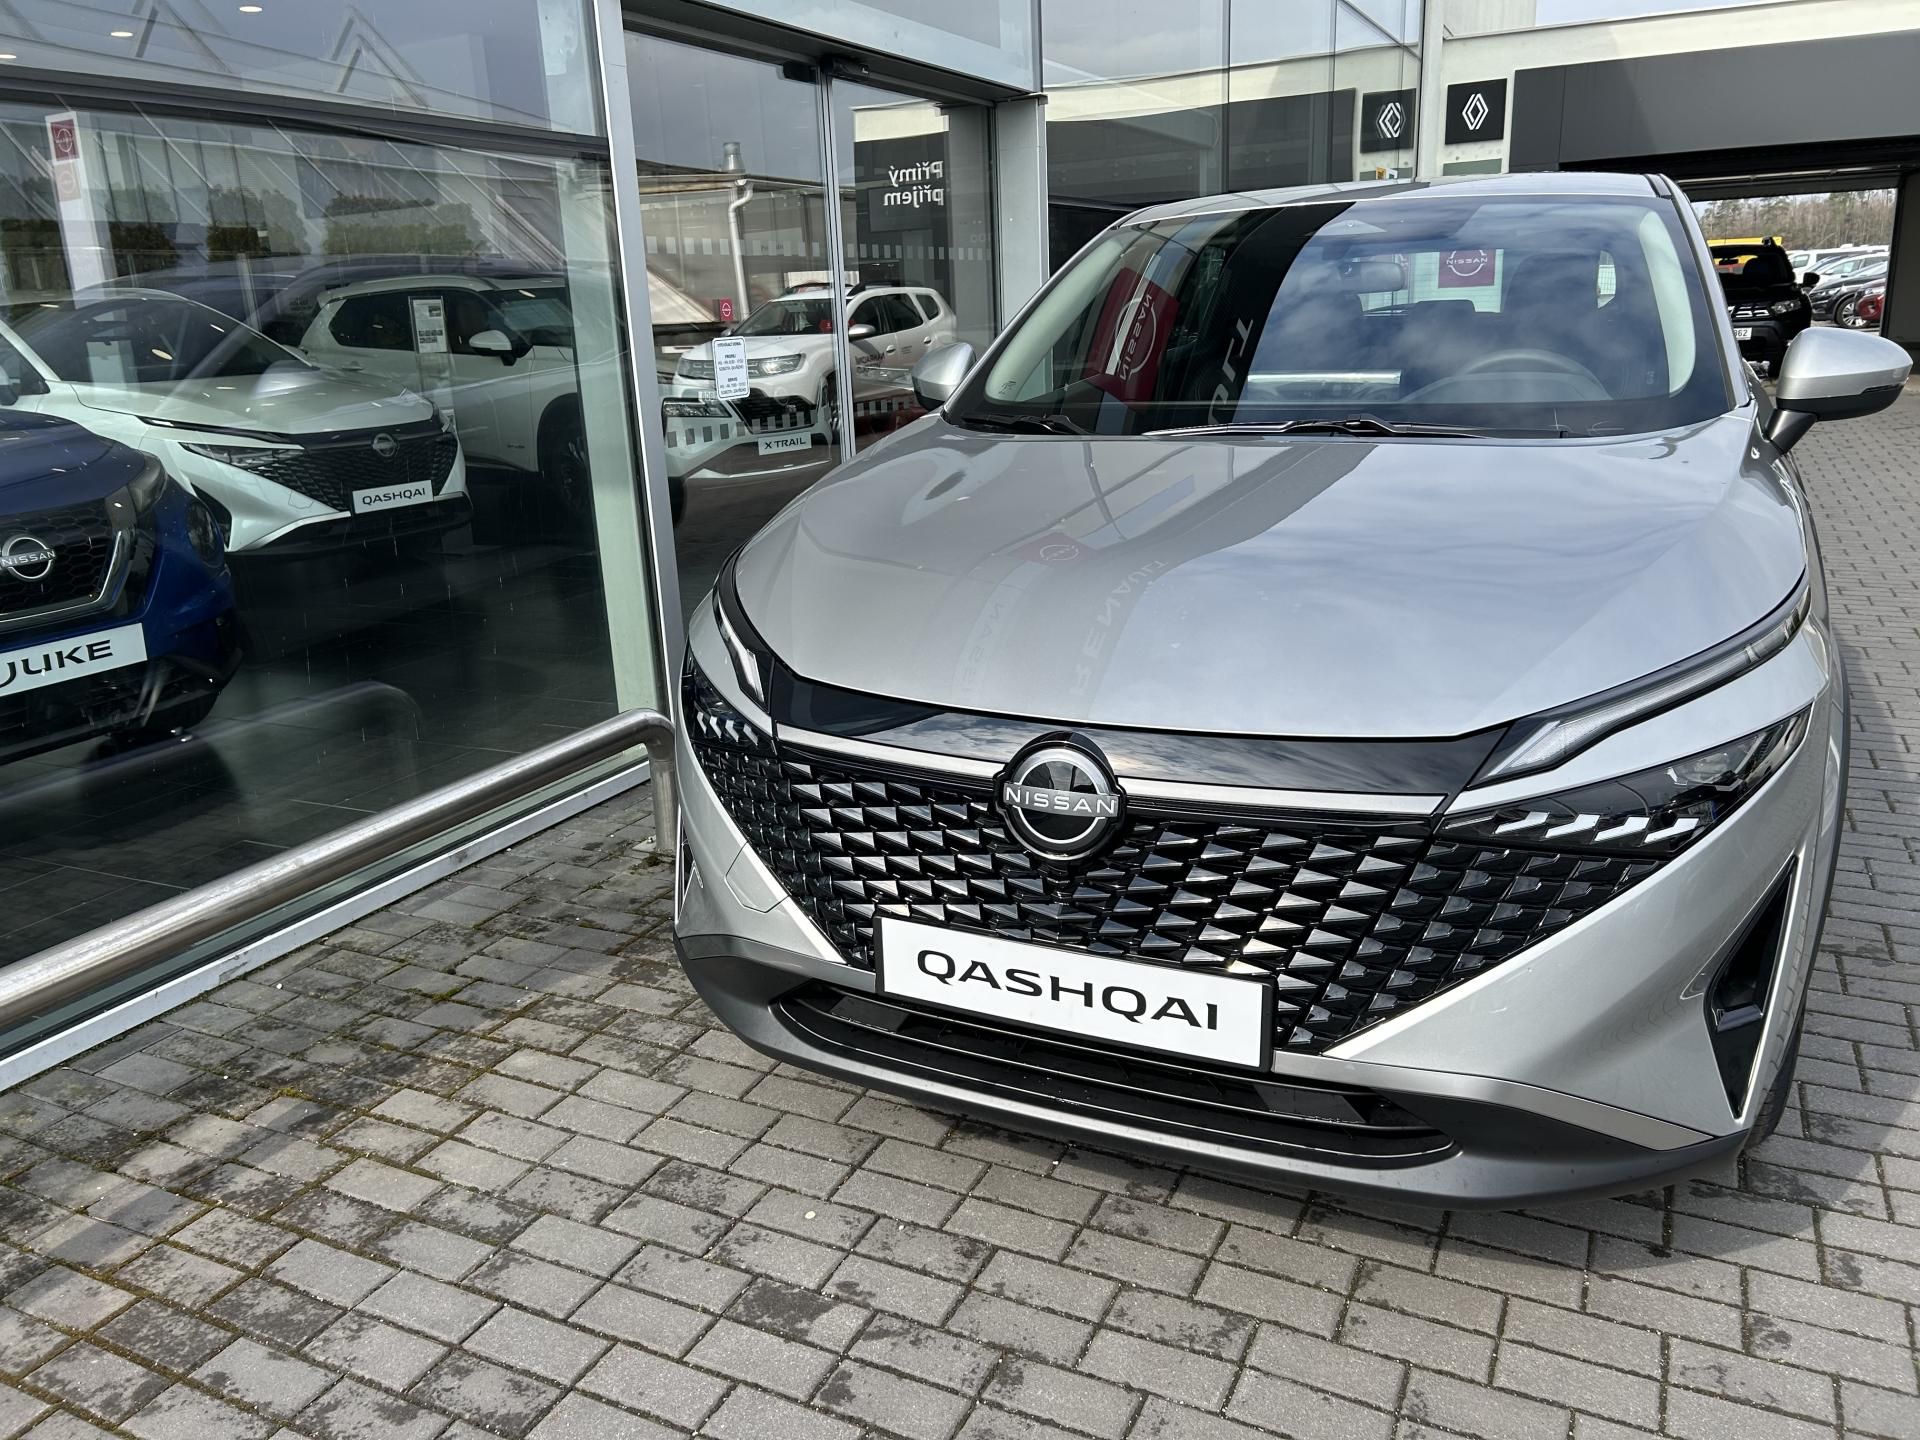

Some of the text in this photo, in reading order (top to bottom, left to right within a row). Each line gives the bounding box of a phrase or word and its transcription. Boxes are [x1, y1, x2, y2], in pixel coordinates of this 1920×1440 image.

[1446, 257, 1488, 265] NISSAN
[774, 437, 806, 448] TRAIL
[362, 487, 426, 506] QASHQAI
[0, 550, 57, 567] NISSAN
[0, 639, 114, 689] JUKE
[1005, 786, 1117, 814] NISSAN
[917, 949, 1218, 1031] QASHQAI
